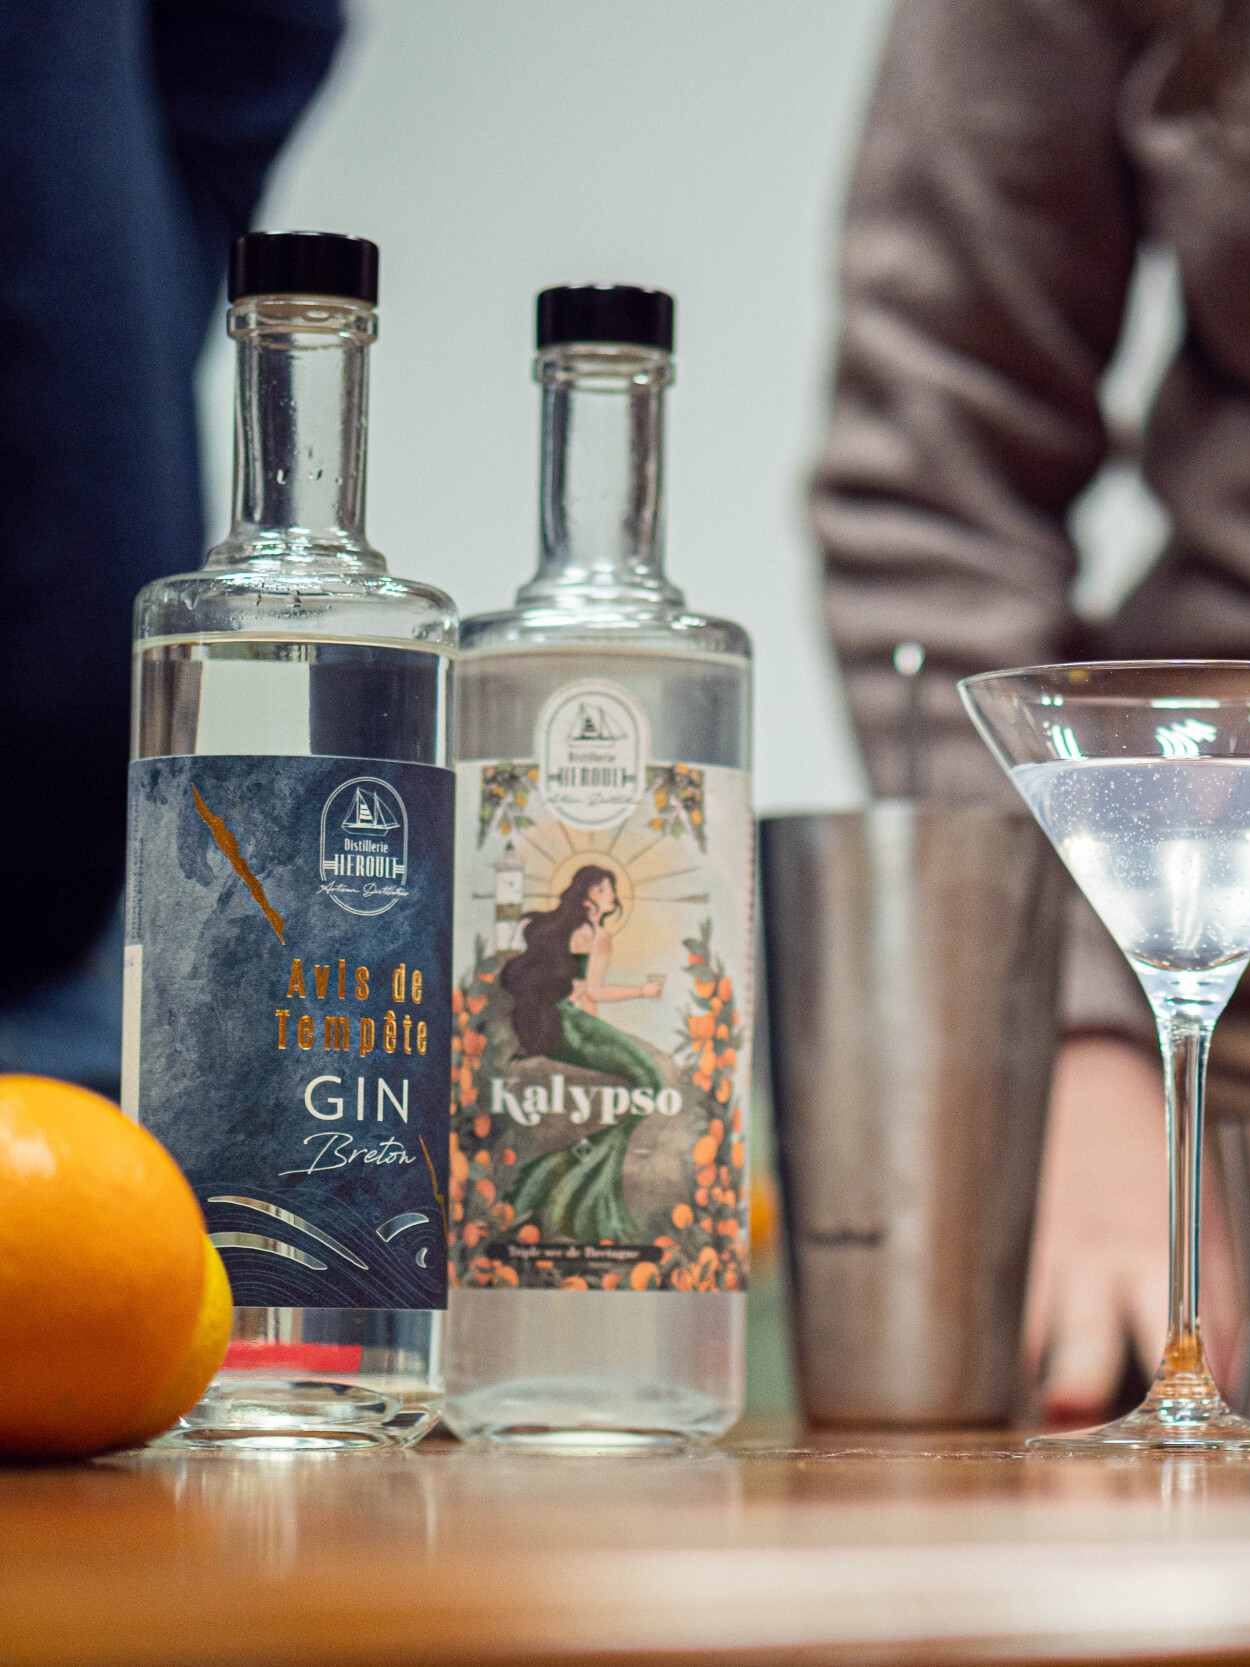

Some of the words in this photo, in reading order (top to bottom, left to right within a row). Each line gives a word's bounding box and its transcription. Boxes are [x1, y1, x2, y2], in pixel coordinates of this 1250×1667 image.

[334, 854, 399, 879] HEROULT
[344, 838, 389, 853] Distillerie
[286, 958, 370, 1001] Avis
[392, 963, 423, 1004] de
[275, 1009, 428, 1057] Tempête
[304, 1075, 409, 1123] GIN
[490, 1073, 683, 1126] Kalypso
[278, 1131, 416, 1176] Breton
